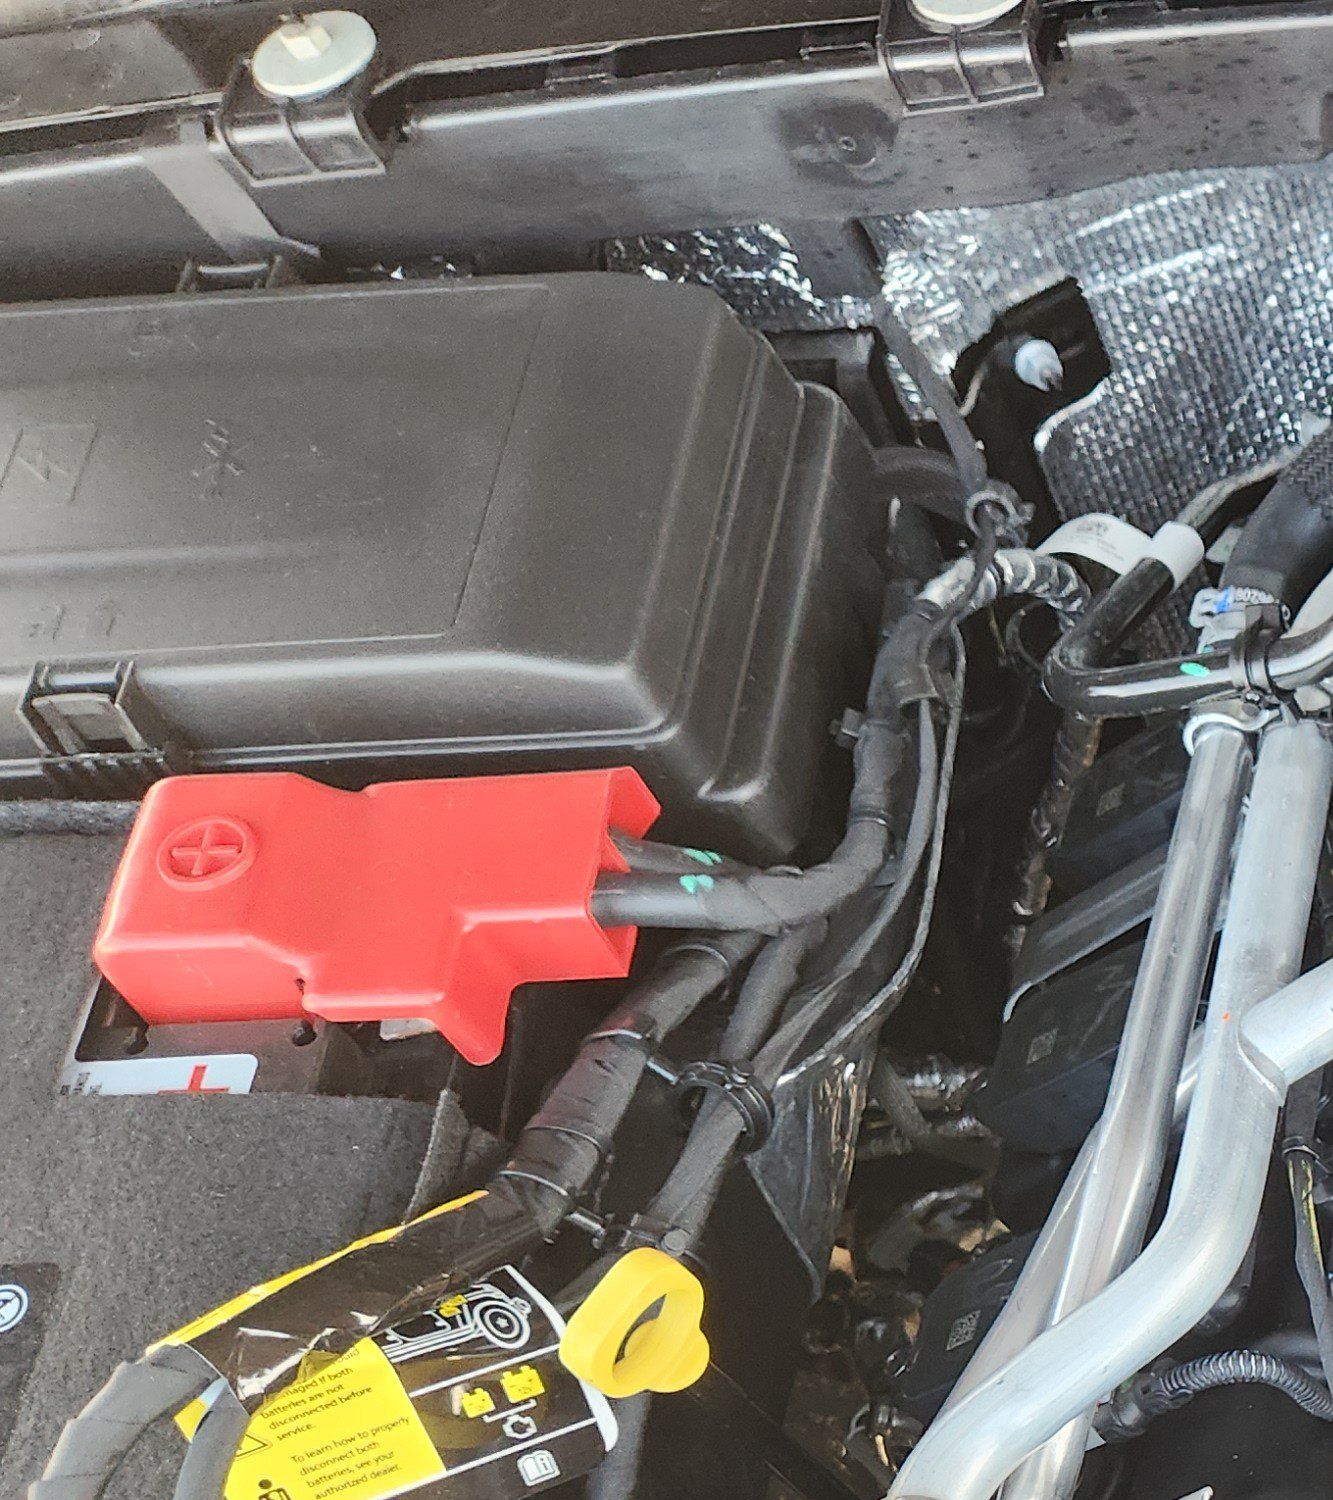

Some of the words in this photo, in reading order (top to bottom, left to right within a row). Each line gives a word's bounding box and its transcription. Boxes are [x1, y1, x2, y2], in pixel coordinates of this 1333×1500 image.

[328, 1366, 354, 1382] both
[261, 1397, 307, 1419] batteries
[309, 1390, 324, 1402] are
[325, 1382, 344, 1396] not
[269, 1398, 339, 1430] disconnected
[339, 1386, 372, 1404] before
[276, 1423, 316, 1441] service.
[290, 1453, 305, 1465] To
[306, 1443, 333, 1460] learn
[333, 1434, 357, 1449] how
[357, 1429, 369, 1440] to
[371, 1416, 410, 1438] properly
[299, 1449, 354, 1477] disconnect
[355, 1440, 381, 1456] both
[306, 1466, 355, 1488] batteries,
[356, 1459, 372, 1469] see
[374, 1450, 396, 1465] your
[315, 1474, 369, 1500] authorized
[370, 1463, 403, 1481] dealer.
